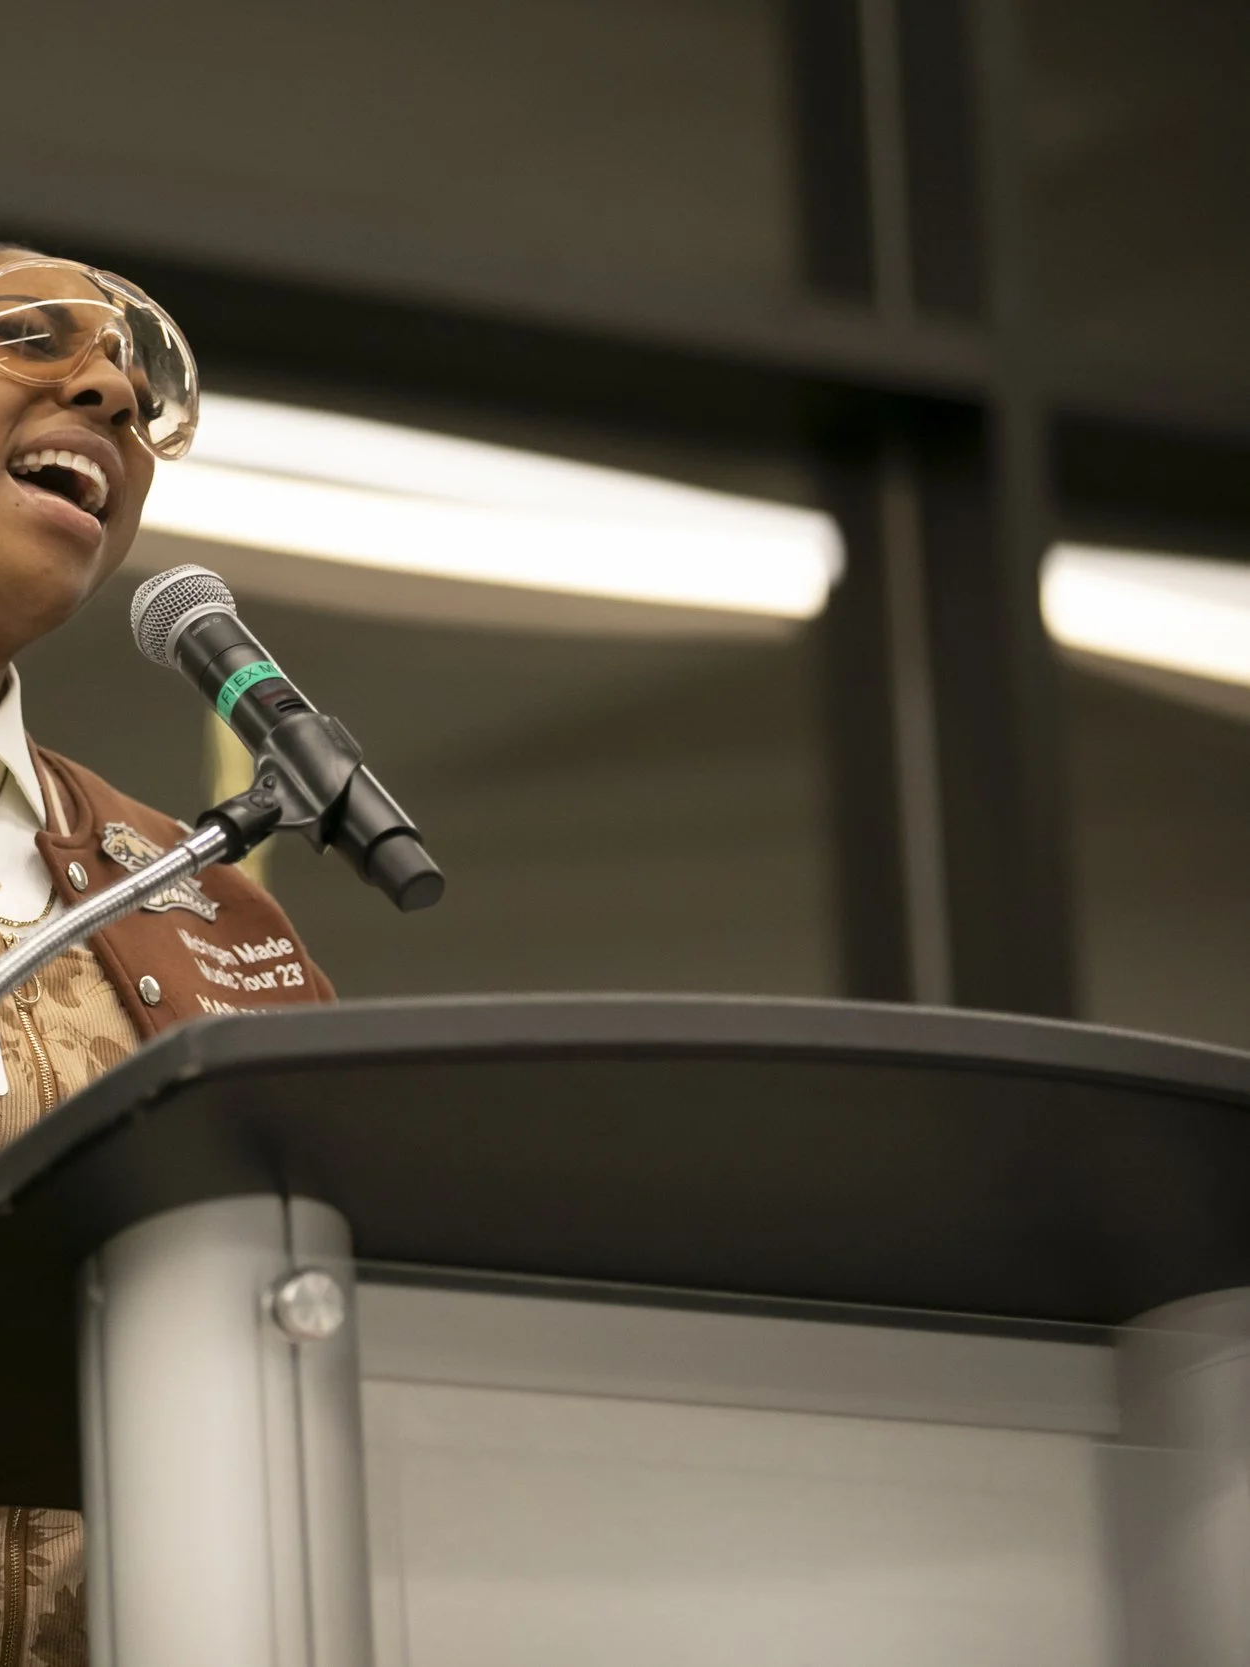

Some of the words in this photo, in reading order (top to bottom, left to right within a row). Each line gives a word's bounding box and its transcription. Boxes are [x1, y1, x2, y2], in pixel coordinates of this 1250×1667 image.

[221, 667, 259, 706] FLEX
[231, 935, 295, 964] Made
[232, 971, 279, 992] Tour
